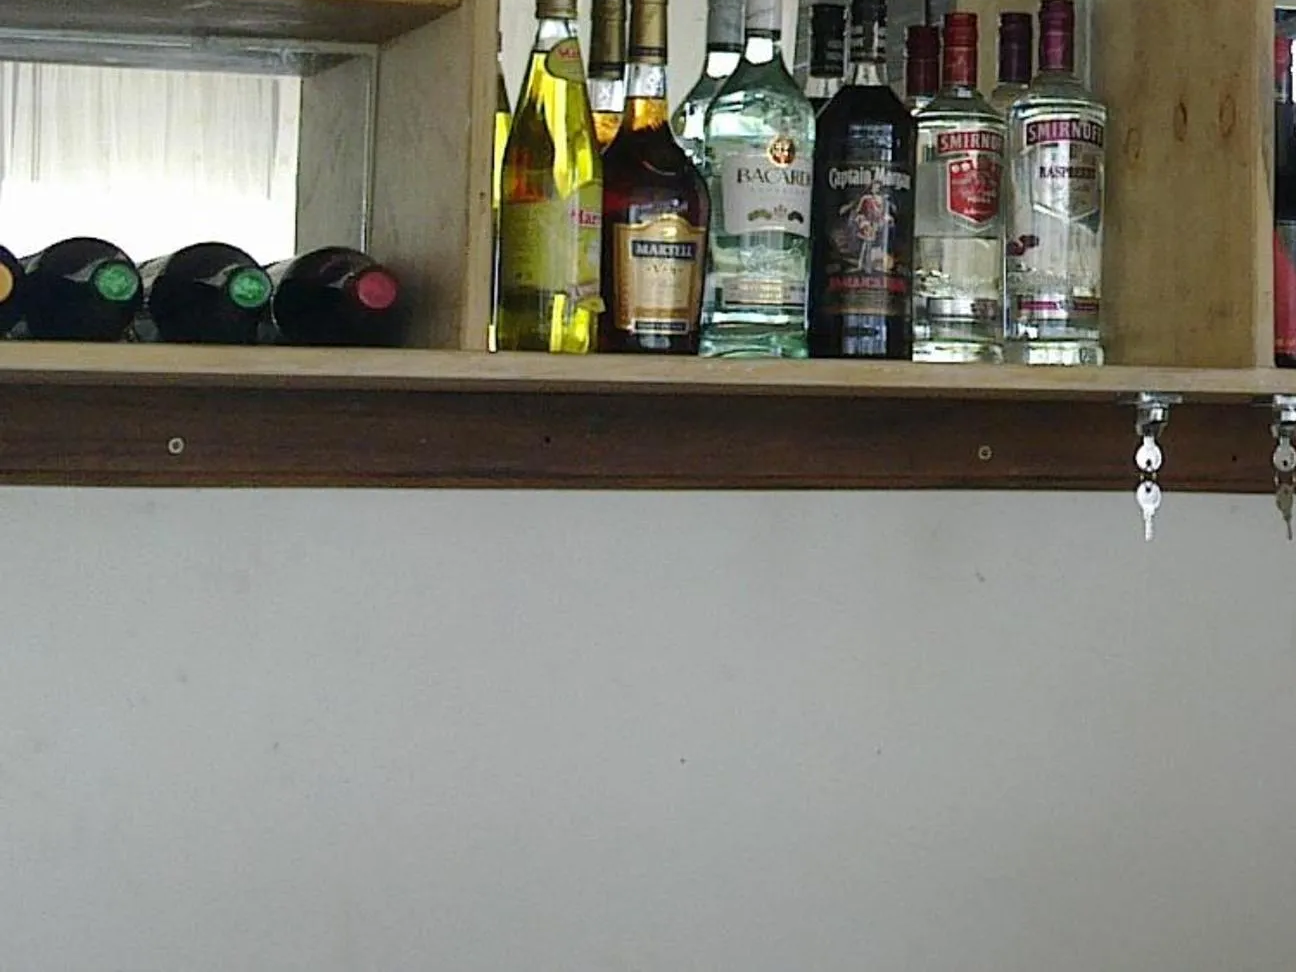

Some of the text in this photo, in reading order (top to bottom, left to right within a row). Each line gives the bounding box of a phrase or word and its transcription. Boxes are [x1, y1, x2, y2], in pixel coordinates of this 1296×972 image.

[938, 131, 1002, 154] SMIRNO
[1027, 120, 1101, 145] SMIRNOF
[736, 167, 811, 187] BACARD
